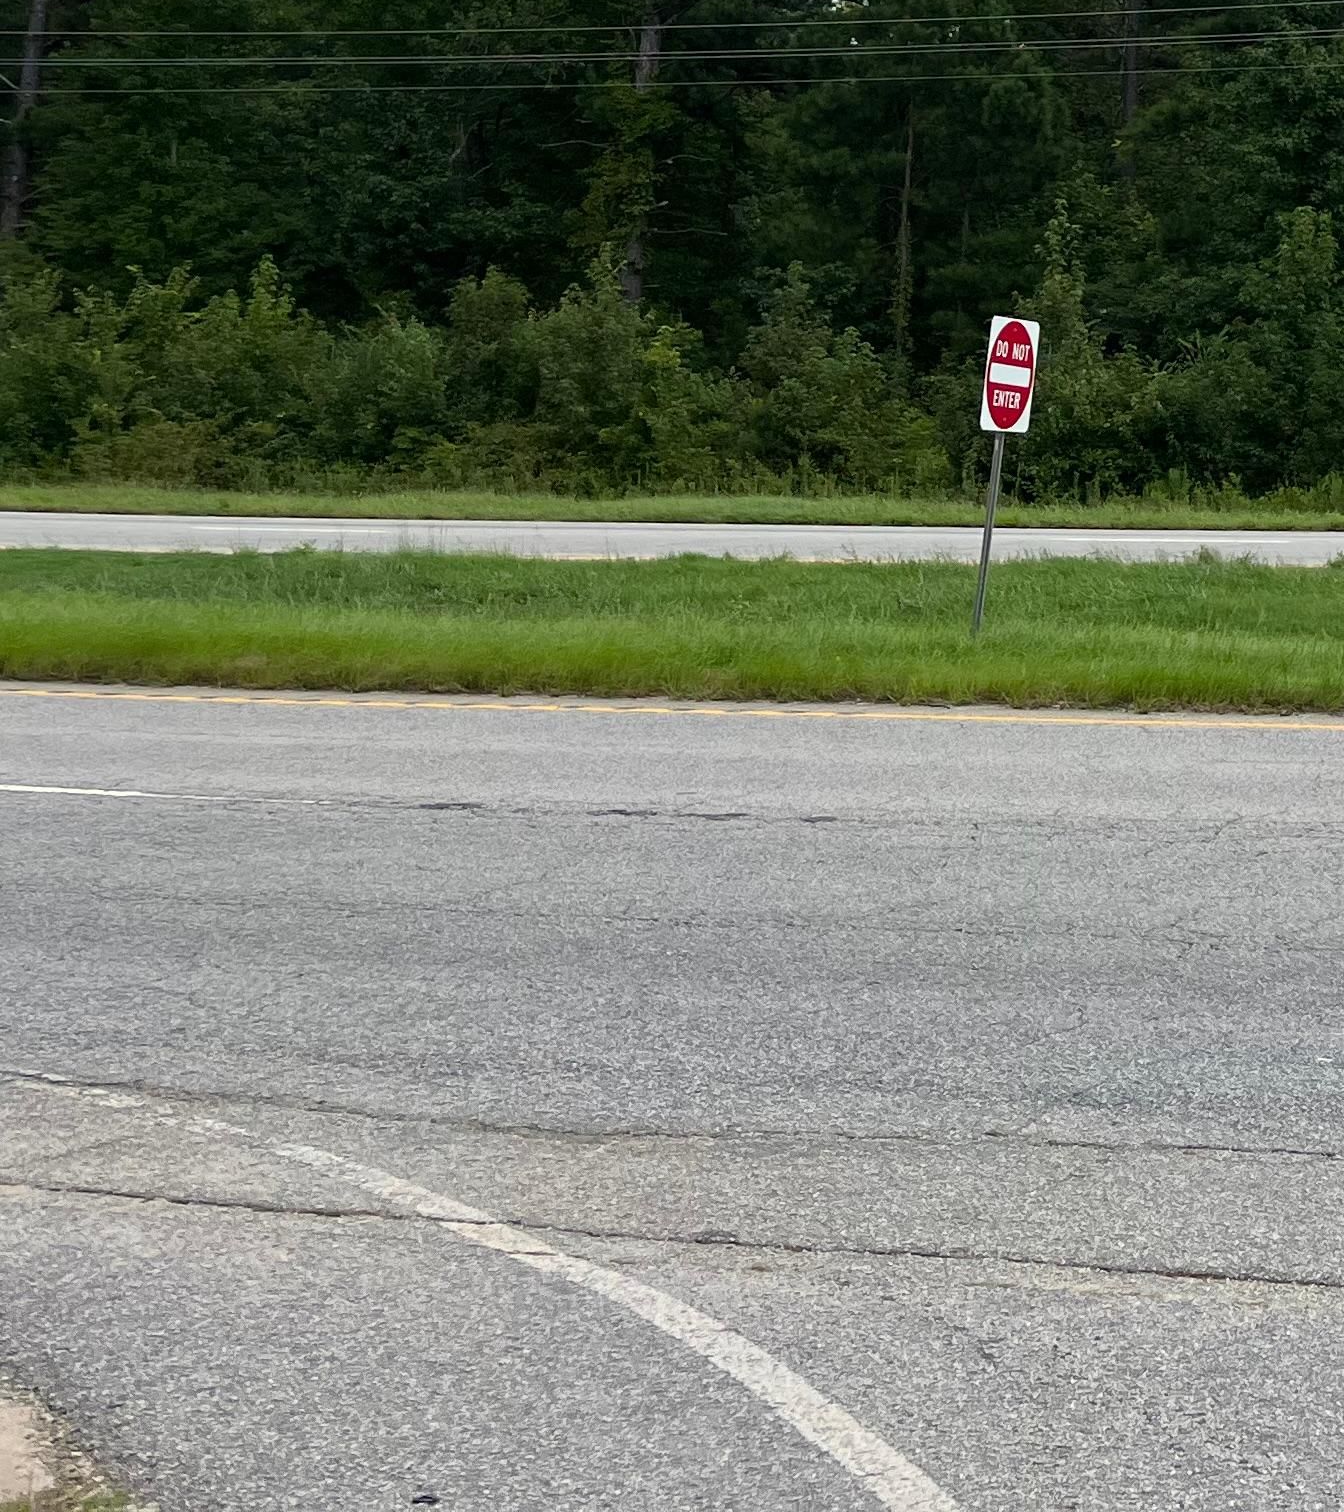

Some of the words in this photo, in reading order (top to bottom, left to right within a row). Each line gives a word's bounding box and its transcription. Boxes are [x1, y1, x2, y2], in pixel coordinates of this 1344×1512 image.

[996, 340, 1009, 357] DO
[1012, 343, 1030, 361] NOT
[993, 390, 1021, 409] ENTER
